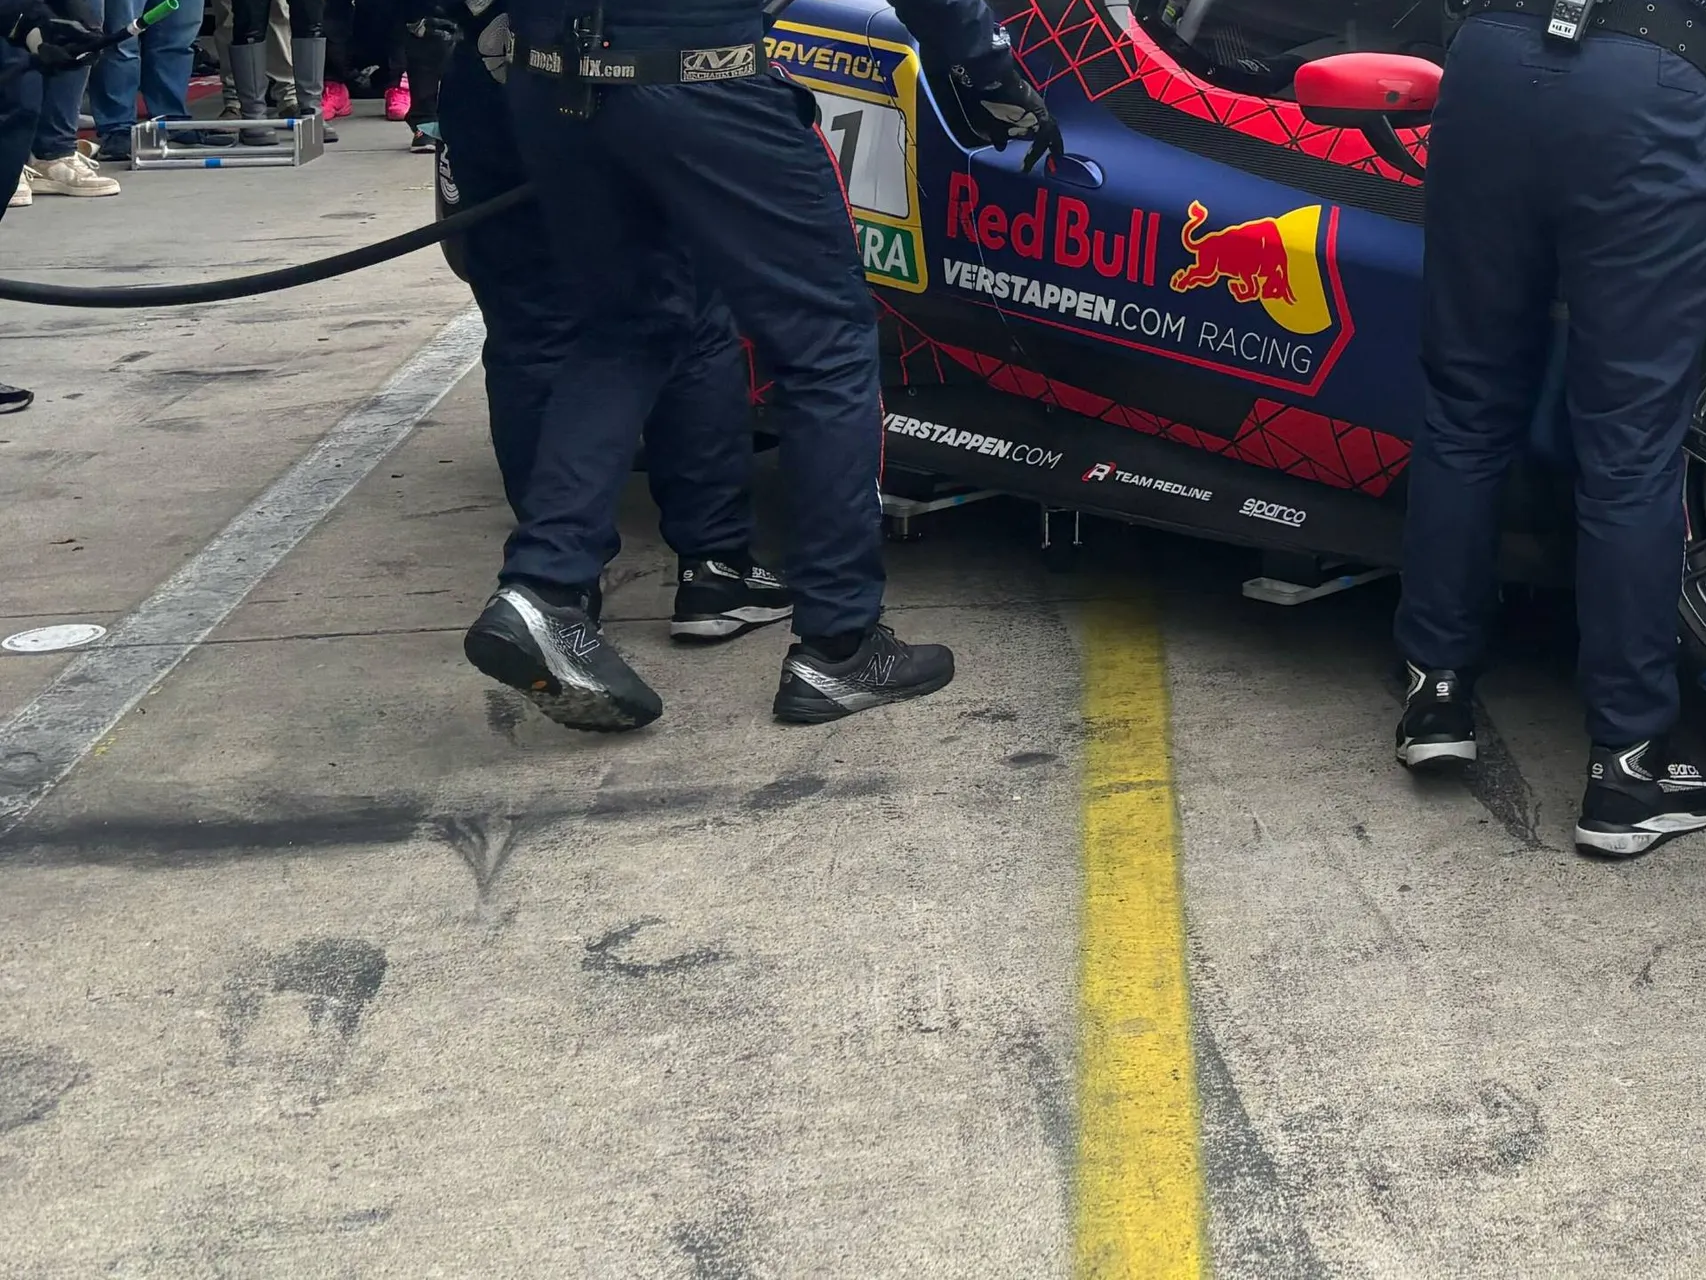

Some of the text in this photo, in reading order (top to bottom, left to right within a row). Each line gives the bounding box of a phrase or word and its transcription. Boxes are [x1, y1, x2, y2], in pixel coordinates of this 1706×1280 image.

[763, 36, 886, 82] RAVENOL
[947, 171, 1161, 287] Red Bull
[943, 257, 1313, 374] VERSTAPPEN.COM RACING
[1114, 469, 1154, 490] TEAM
[1153, 478, 1213, 502] REDLINE
[1239, 497, 1307, 527] sparco
